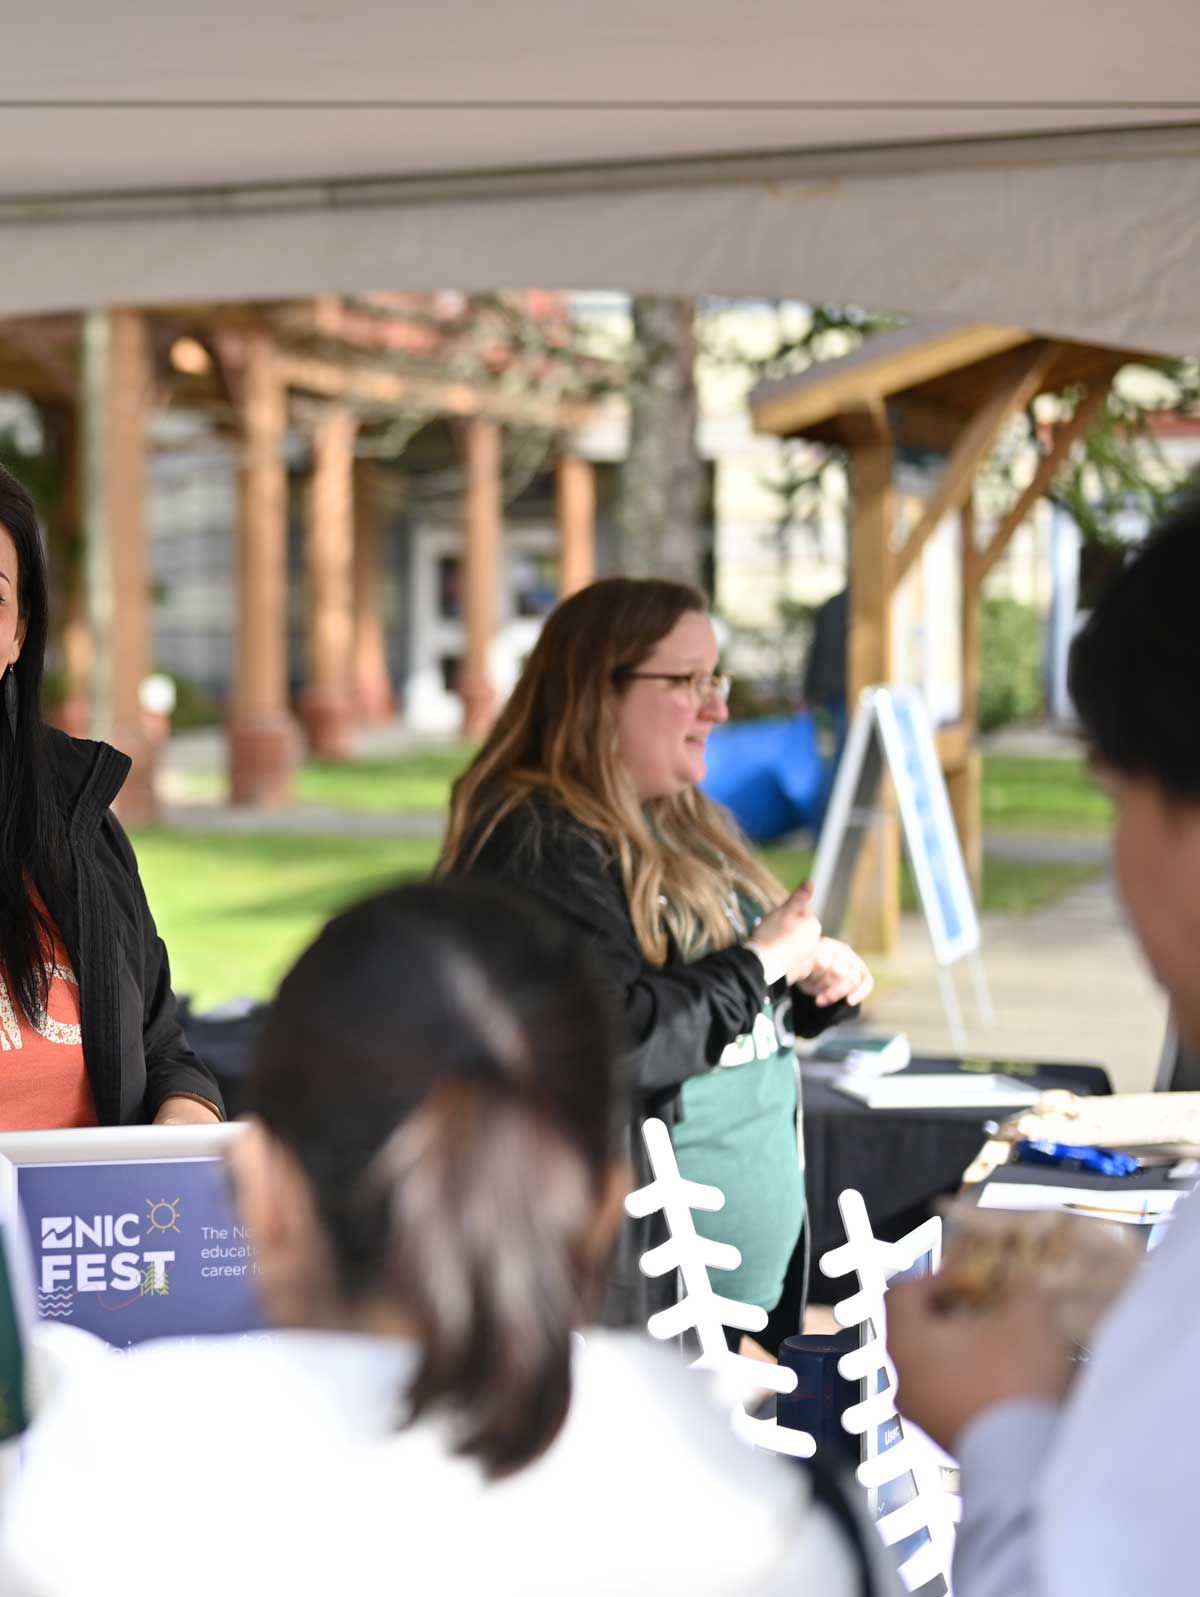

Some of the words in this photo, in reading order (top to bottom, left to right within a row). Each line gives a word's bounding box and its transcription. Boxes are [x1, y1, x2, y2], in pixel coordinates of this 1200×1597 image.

[75, 1213, 140, 1248] NIC
[200, 1226, 228, 1241] The
[42, 1251, 176, 1293] FEST
[201, 1265, 247, 1277] career
